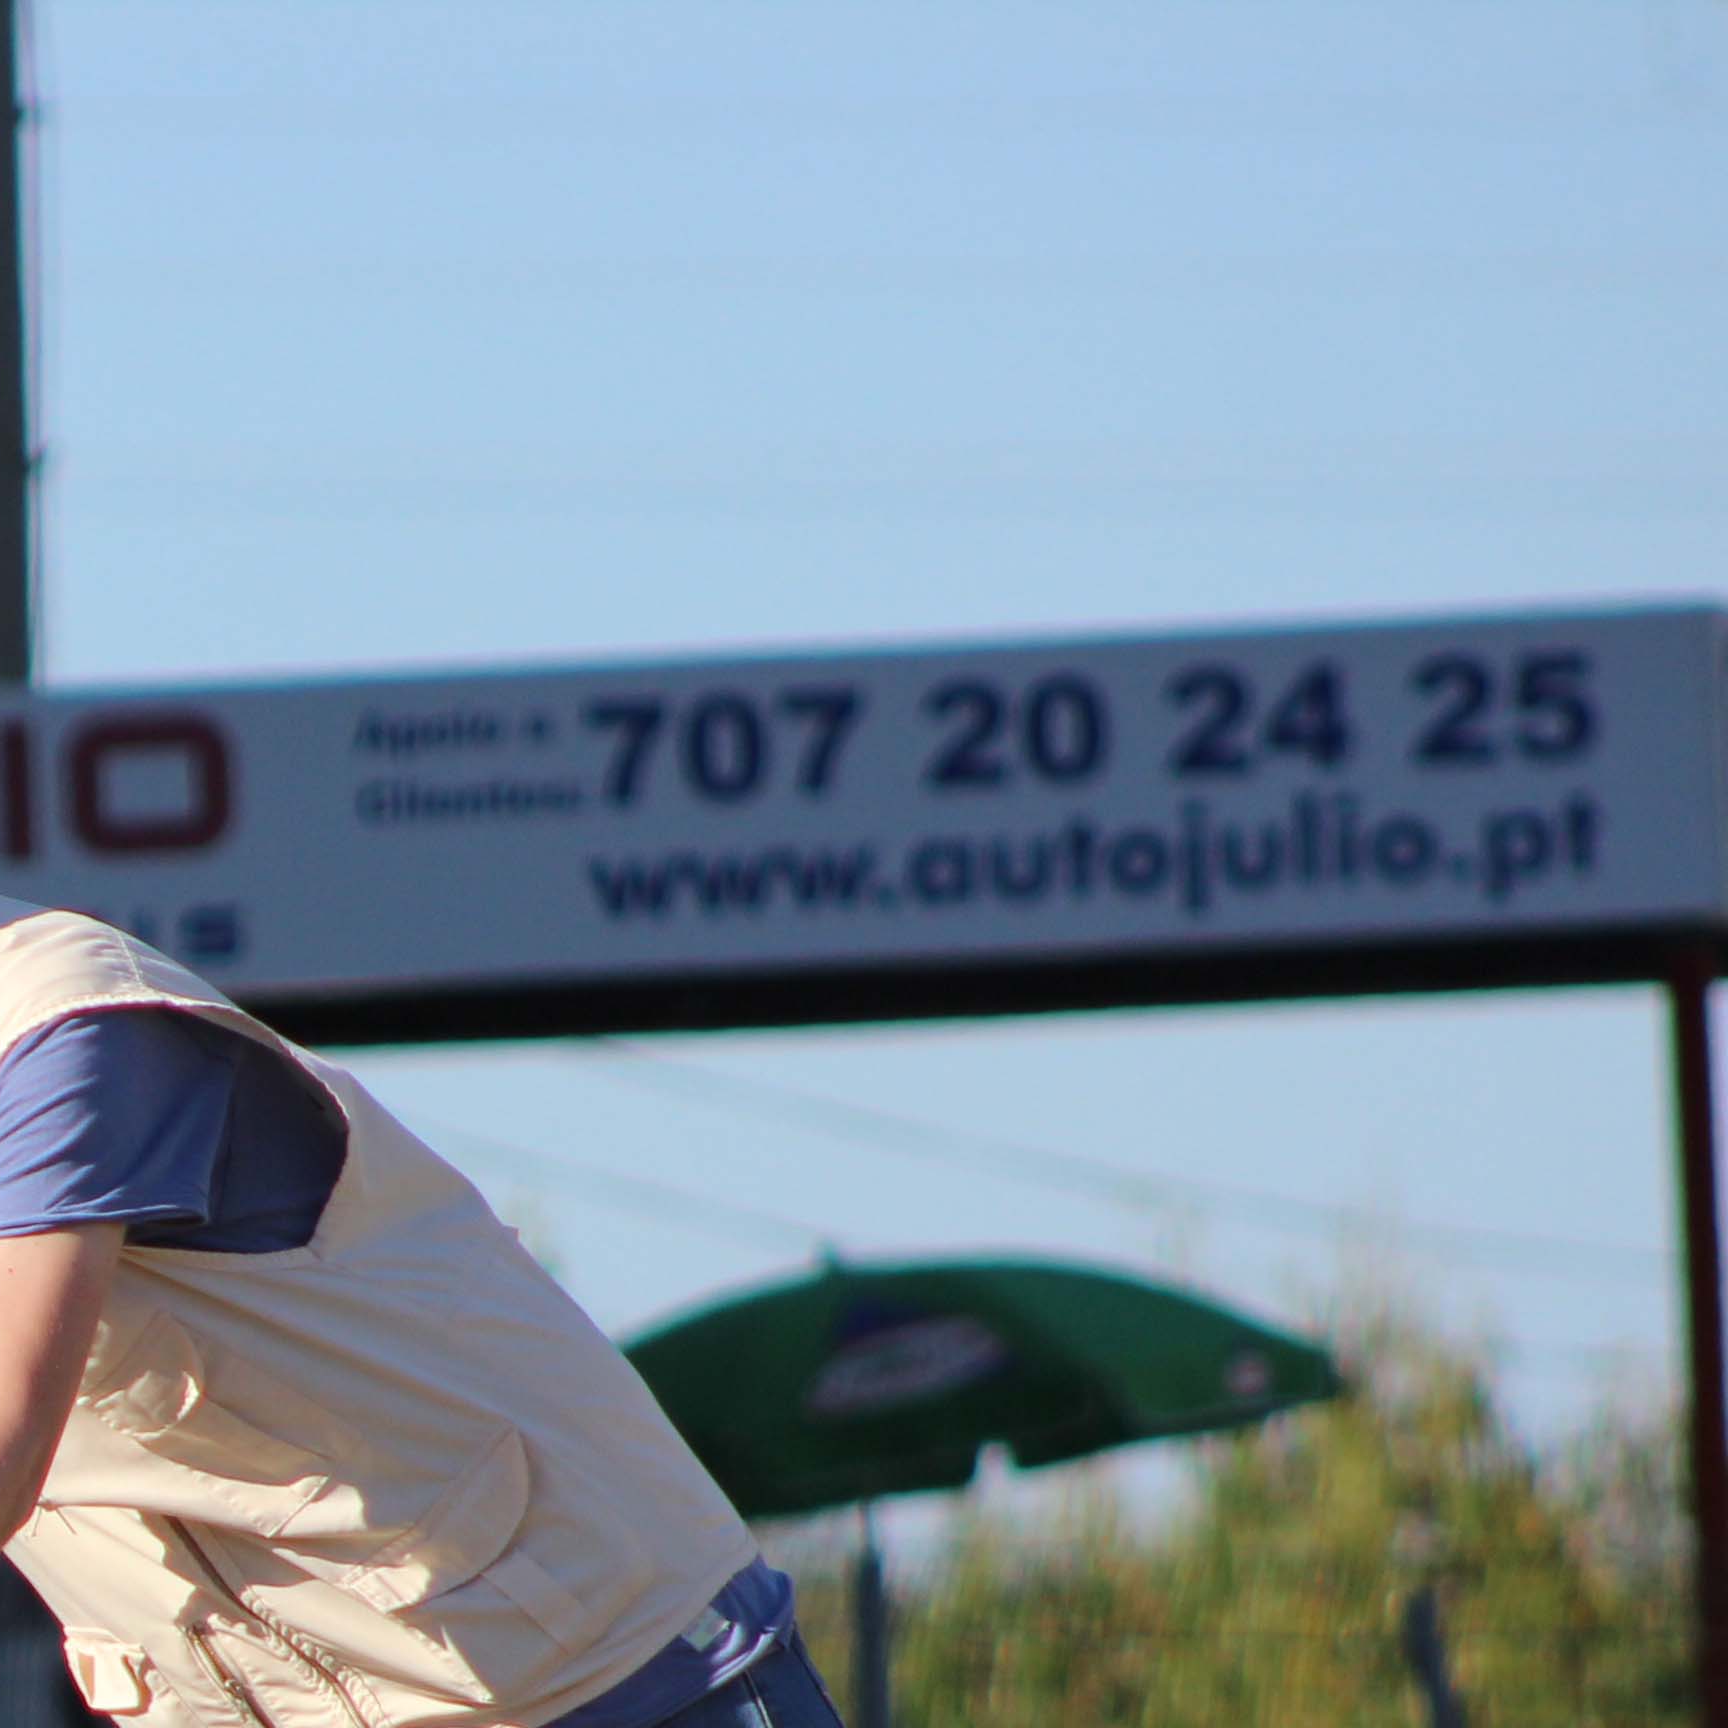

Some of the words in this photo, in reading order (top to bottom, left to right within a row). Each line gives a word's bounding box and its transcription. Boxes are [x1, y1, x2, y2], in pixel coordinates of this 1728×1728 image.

[582, 680, 865, 803] 707
[924, 672, 1110, 790] 20
[1162, 656, 1350, 778] 24
[1410, 648, 1600, 770] 25
[586, 790, 1600, 919] www.autojulio.pt
